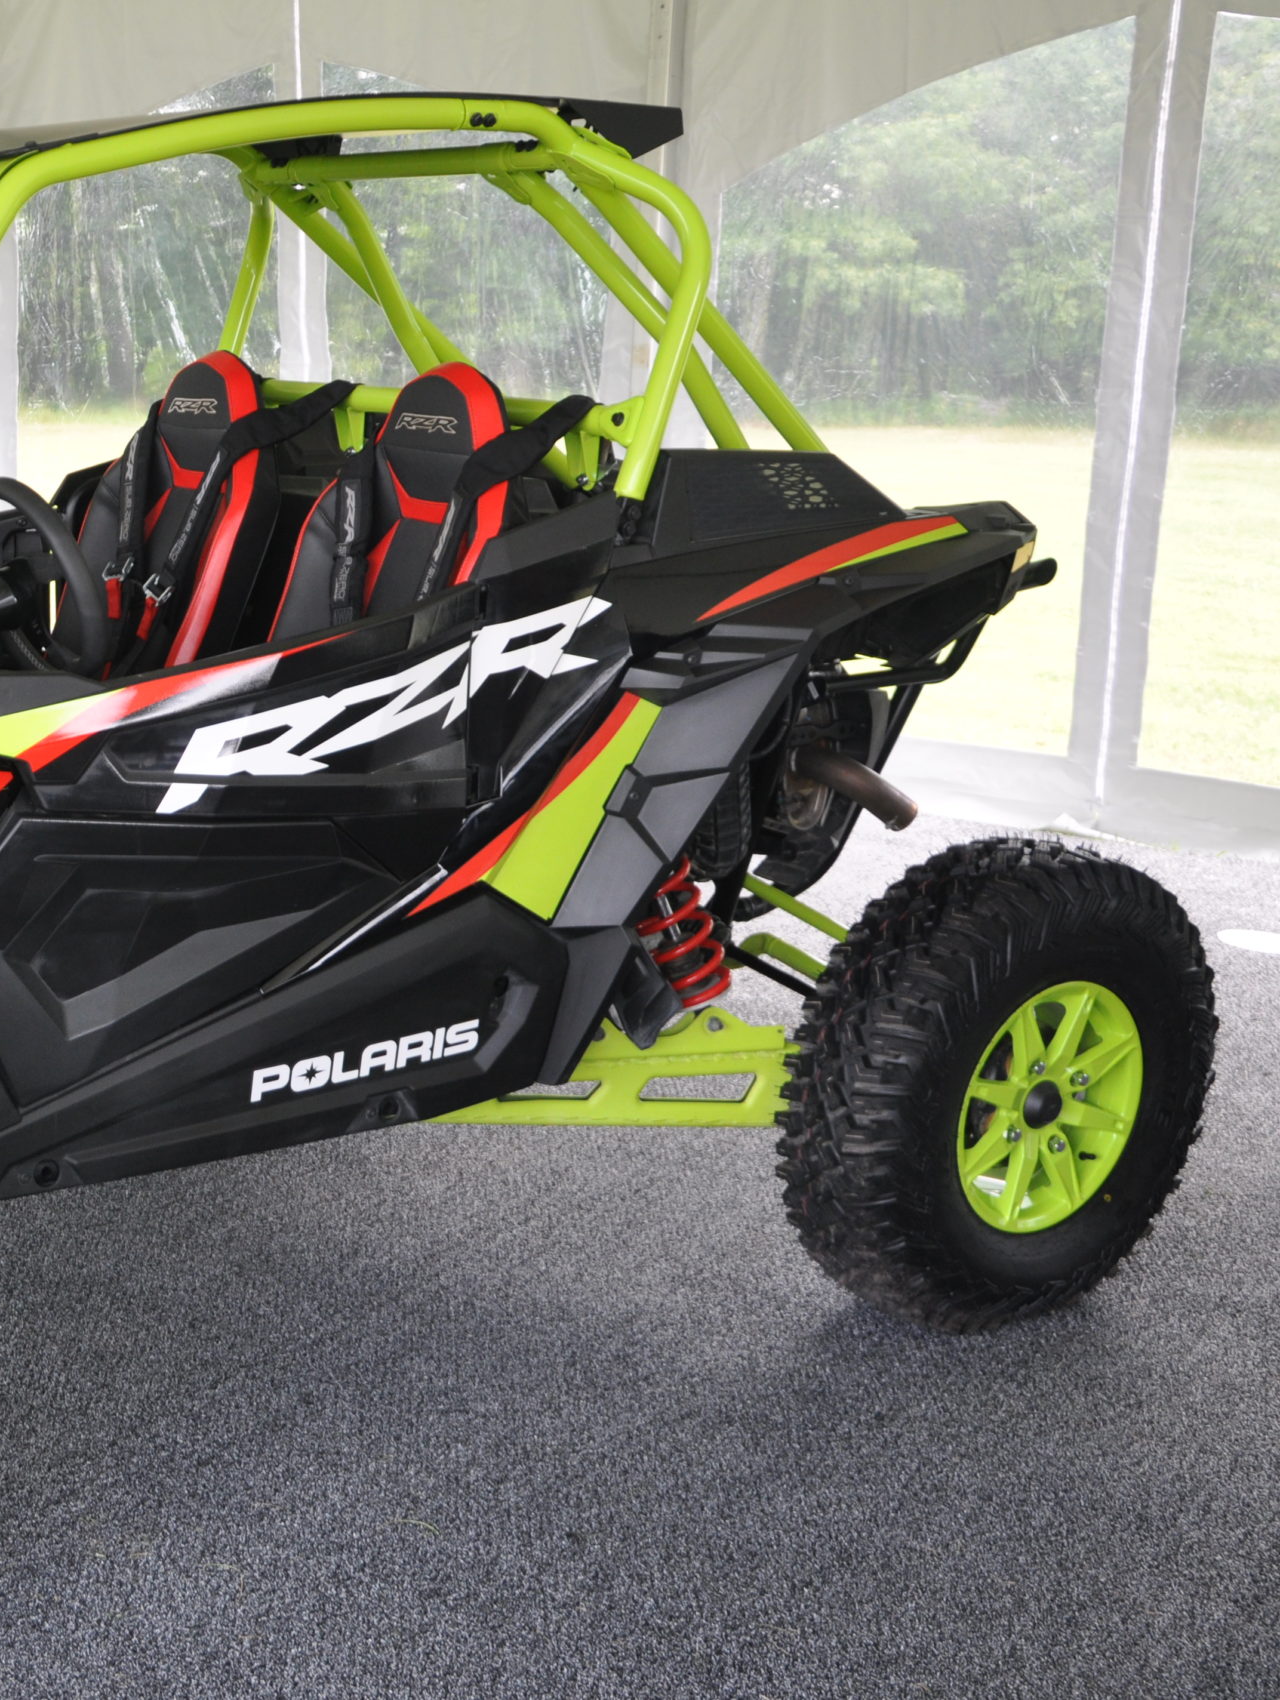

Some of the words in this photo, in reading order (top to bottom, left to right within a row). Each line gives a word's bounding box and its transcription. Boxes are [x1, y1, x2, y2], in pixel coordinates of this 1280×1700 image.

[168, 397, 218, 415] RZR
[395, 412, 458, 434] RZR
[155, 596, 612, 814] RZR
[250, 1019, 480, 1103] POLARIS
